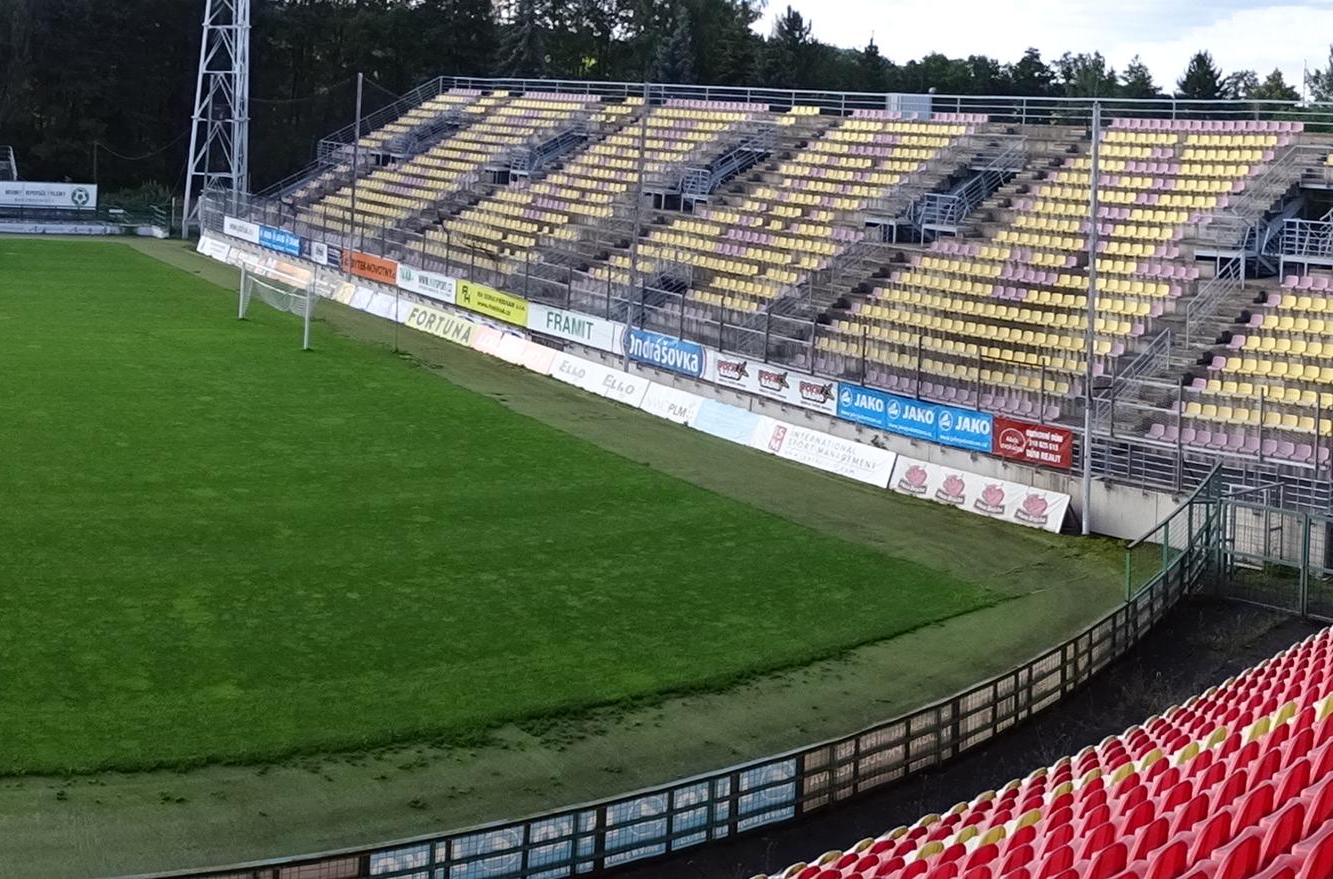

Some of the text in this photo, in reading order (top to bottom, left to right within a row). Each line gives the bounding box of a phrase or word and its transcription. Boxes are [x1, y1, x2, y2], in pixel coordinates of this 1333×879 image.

[407, 307, 473, 344] FORTUNA
[546, 311, 594, 341] FRAMIT
[854, 393, 884, 413] JAKO
[902, 405, 934, 425] JAKO
[955, 415, 991, 436] JAKO
